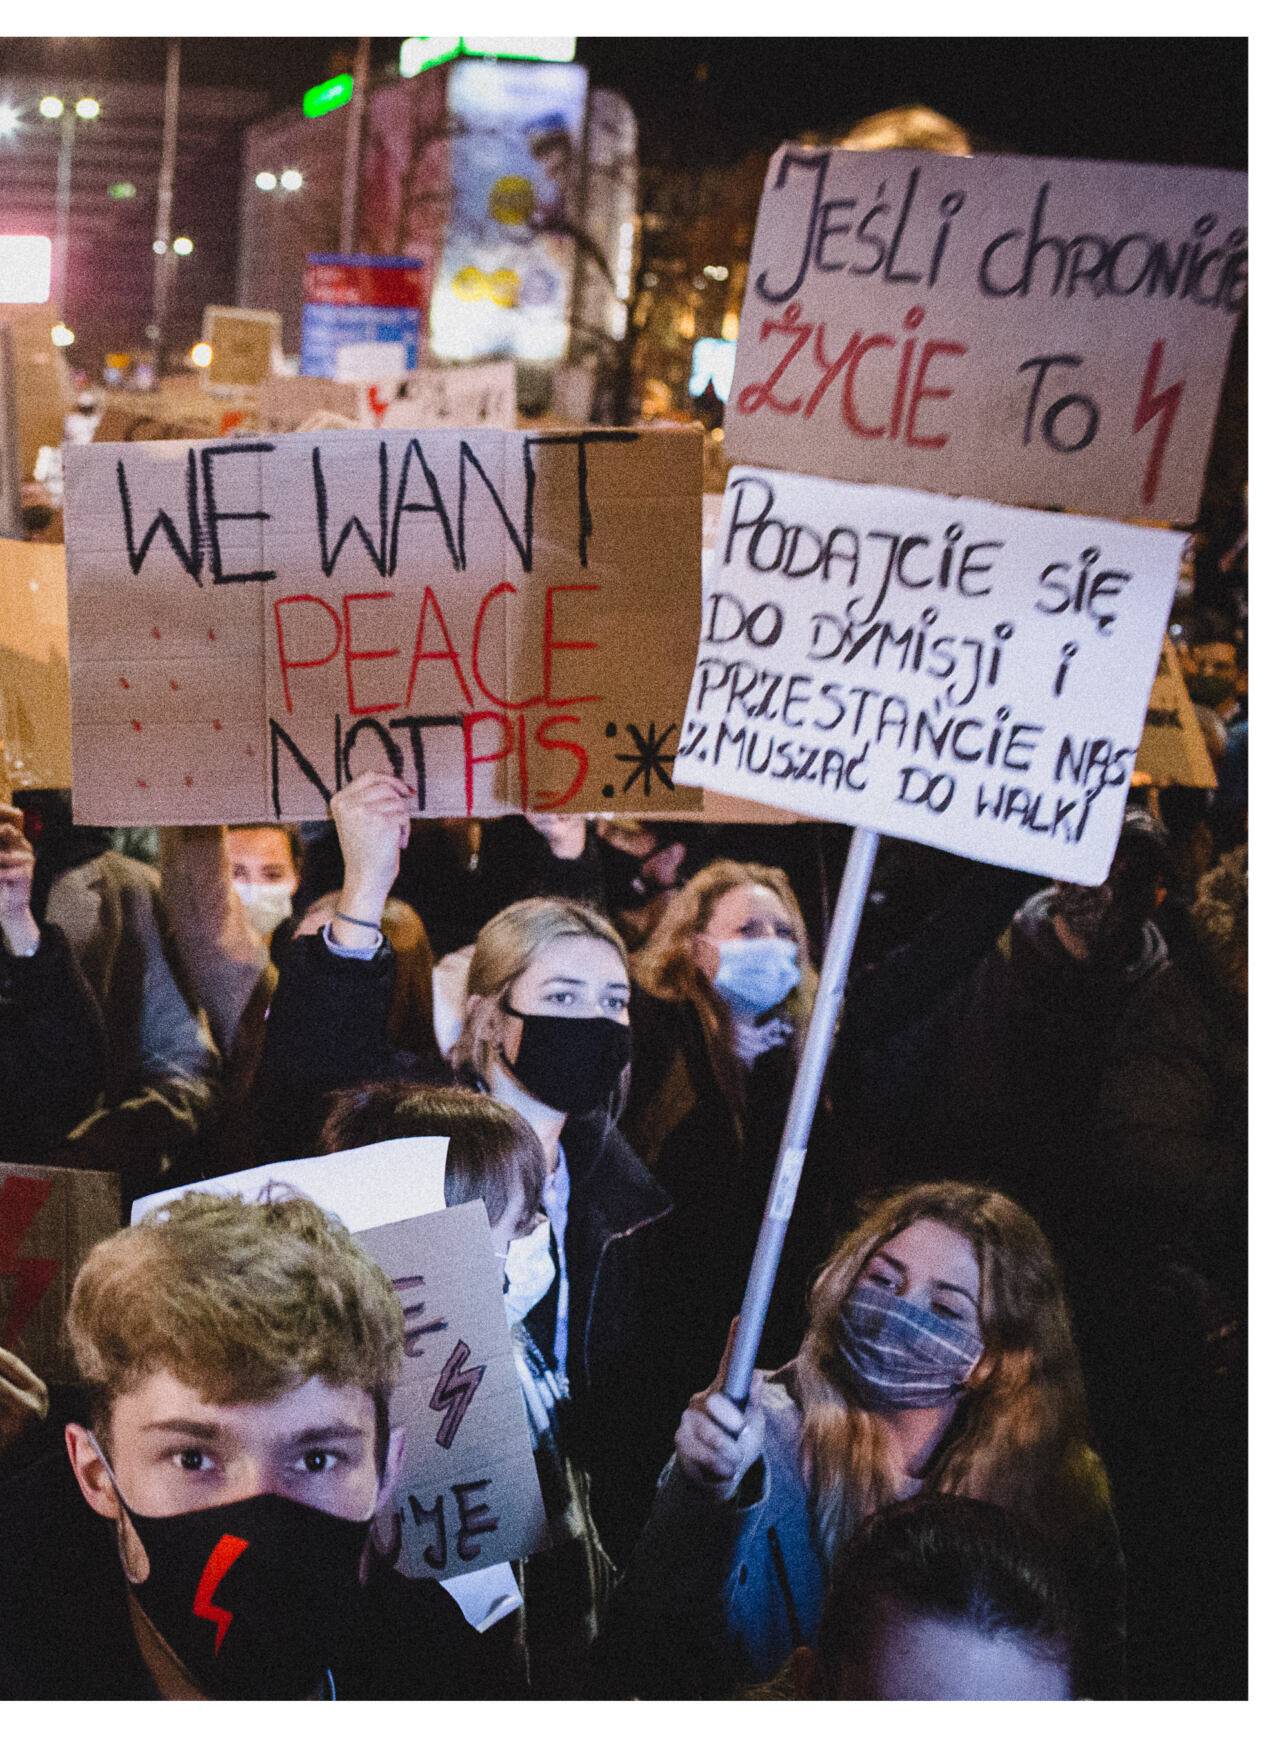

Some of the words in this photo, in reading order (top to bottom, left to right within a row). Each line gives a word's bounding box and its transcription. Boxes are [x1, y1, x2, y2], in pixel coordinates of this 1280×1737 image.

[116, 443, 276, 588] WE
[314, 430, 641, 578] WANT
[273, 581, 604, 715] PEACE
[705, 594, 784, 647] DO
[269, 712, 466, 820] NOT
[462, 709, 590, 817] PIS
[897, 766, 956, 814] DO
[1054, 735, 1137, 789] NAS
